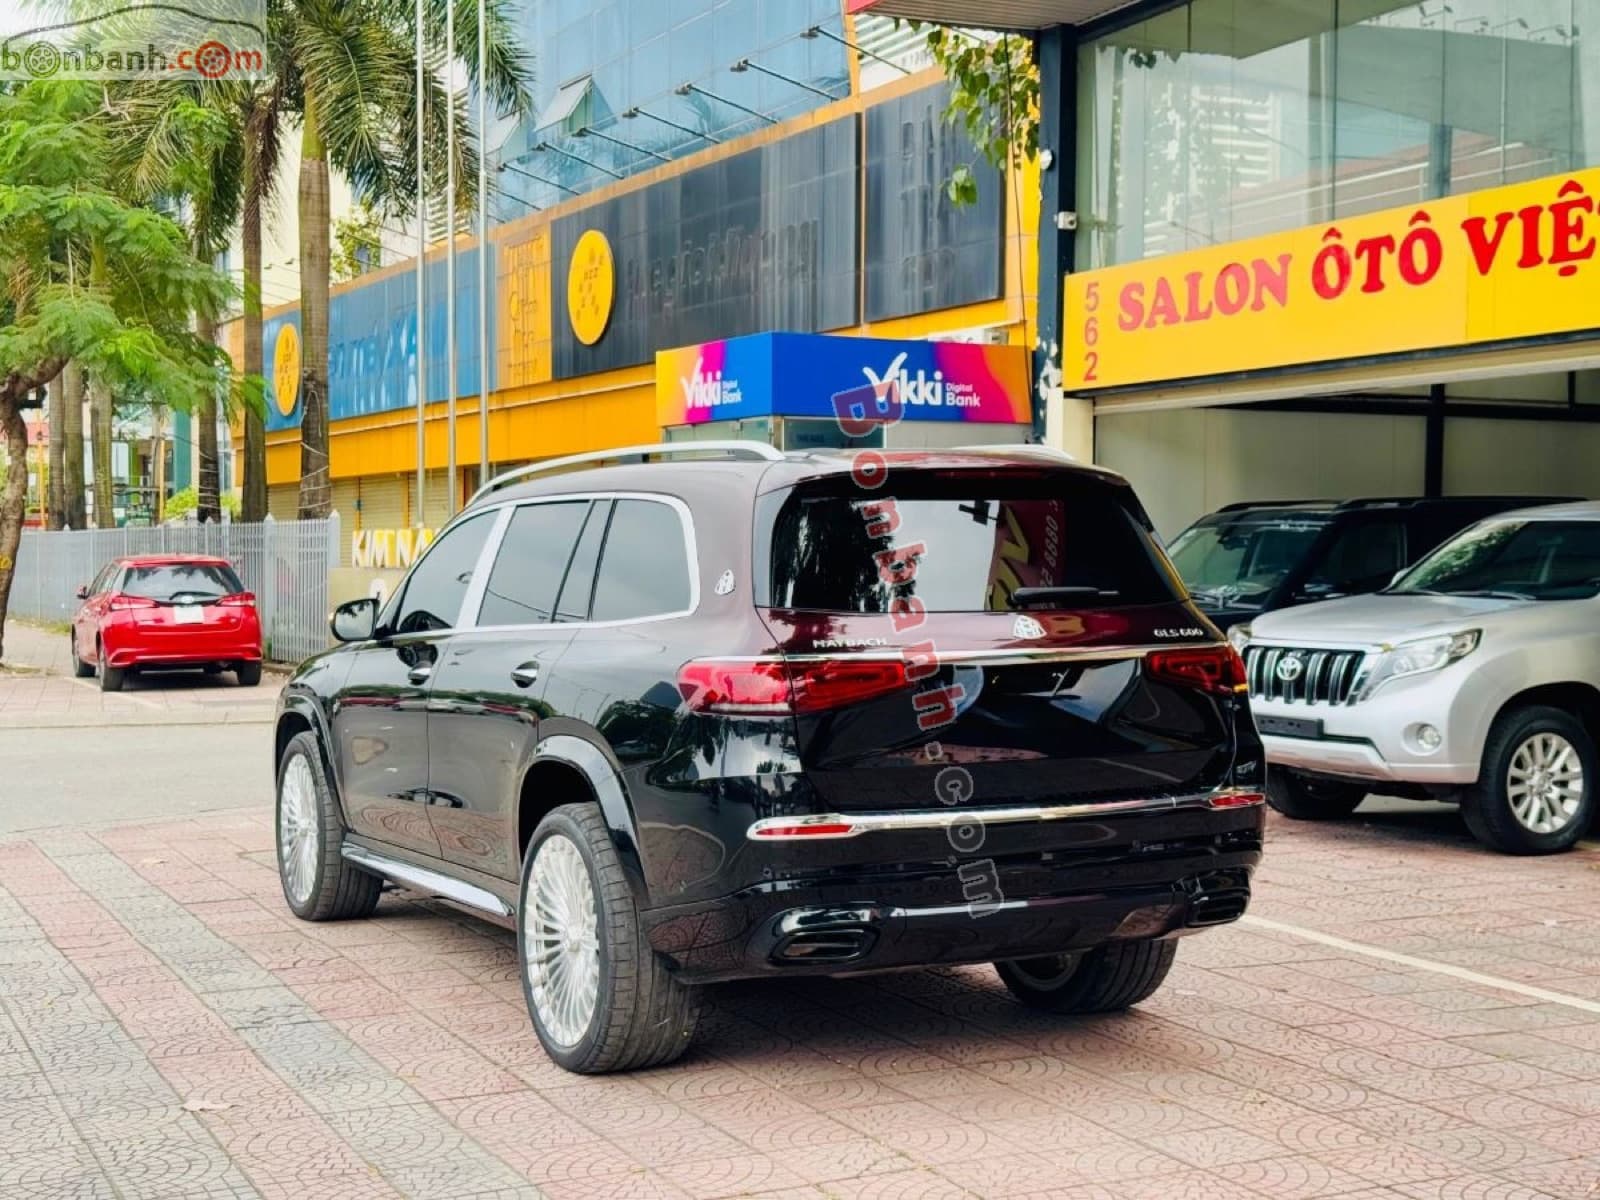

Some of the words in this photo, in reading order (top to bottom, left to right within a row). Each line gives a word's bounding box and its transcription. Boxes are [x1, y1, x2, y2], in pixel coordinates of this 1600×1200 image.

[1117, 253, 1293, 332] SALON
[1311, 209, 1443, 300] ÔTÔ
[1460, 179, 1600, 277] VIỆ
[680, 356, 722, 409] Vikki
[862, 351, 944, 406] Vikki
[723, 388, 743, 404] Bank
[946, 382, 973, 394] Digital
[945, 391, 981, 408] Bank
[396, 527, 442, 569] NA
[1153, 628, 1179, 638] GLS
[1179, 627, 1204, 637] 600
[812, 638, 888, 648] MAYBACH
